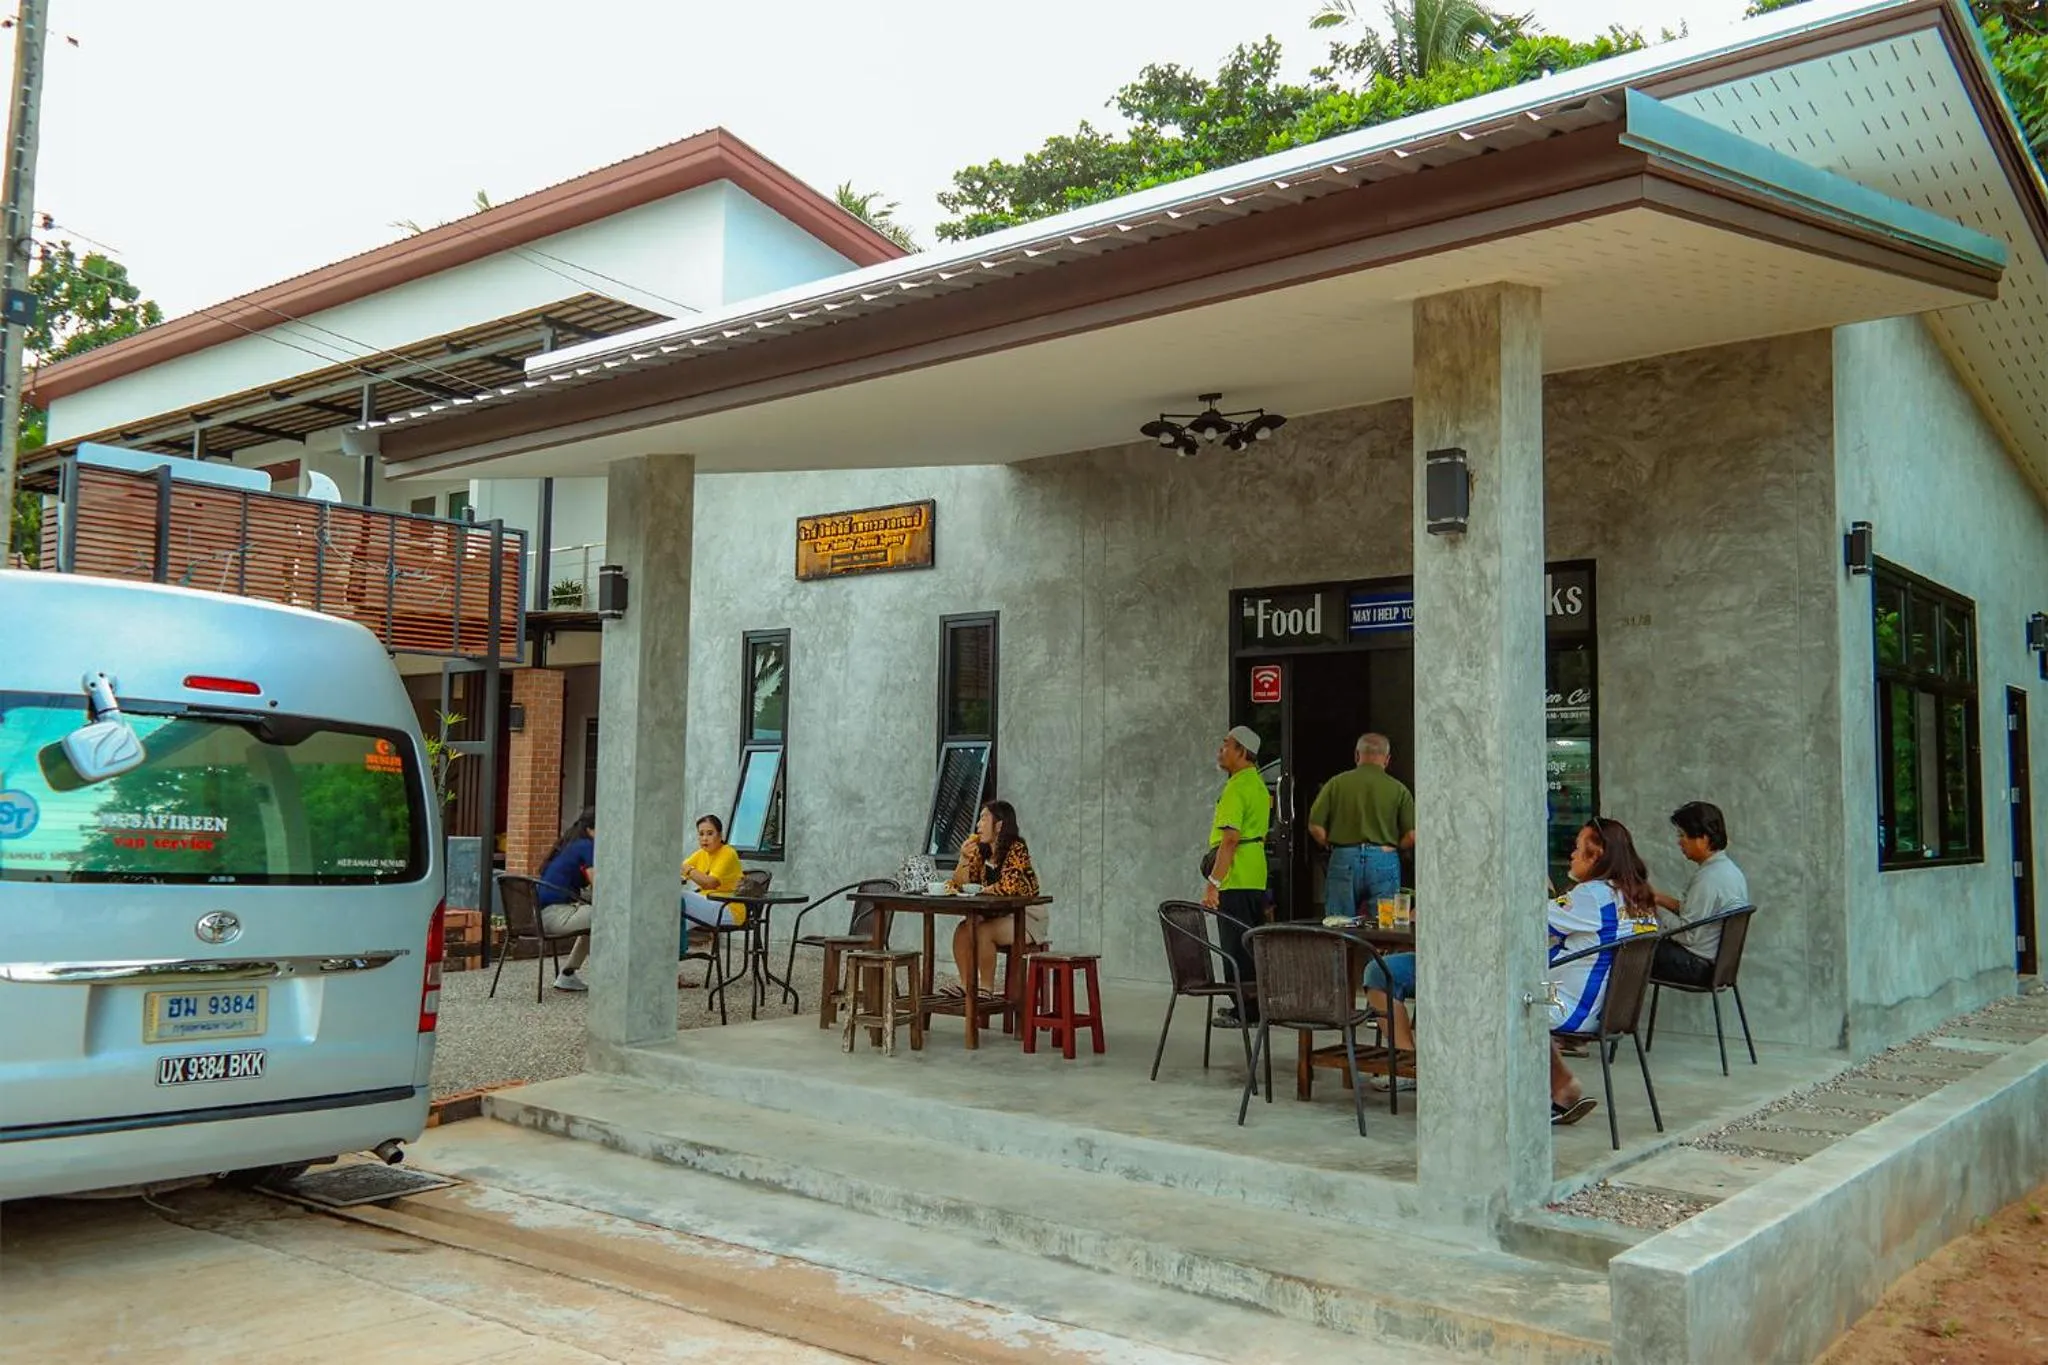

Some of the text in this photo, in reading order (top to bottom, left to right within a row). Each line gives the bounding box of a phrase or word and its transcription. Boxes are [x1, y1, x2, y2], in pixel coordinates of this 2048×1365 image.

[1257, 593, 1321, 638] Food
[1353, 608, 1371, 623] MAY
[1378, 606, 1400, 621] HELP
[114, 836, 215, 851] van service
[209, 994, 256, 1016] 9384
[161, 1052, 264, 1084] UX 9384 BKK
